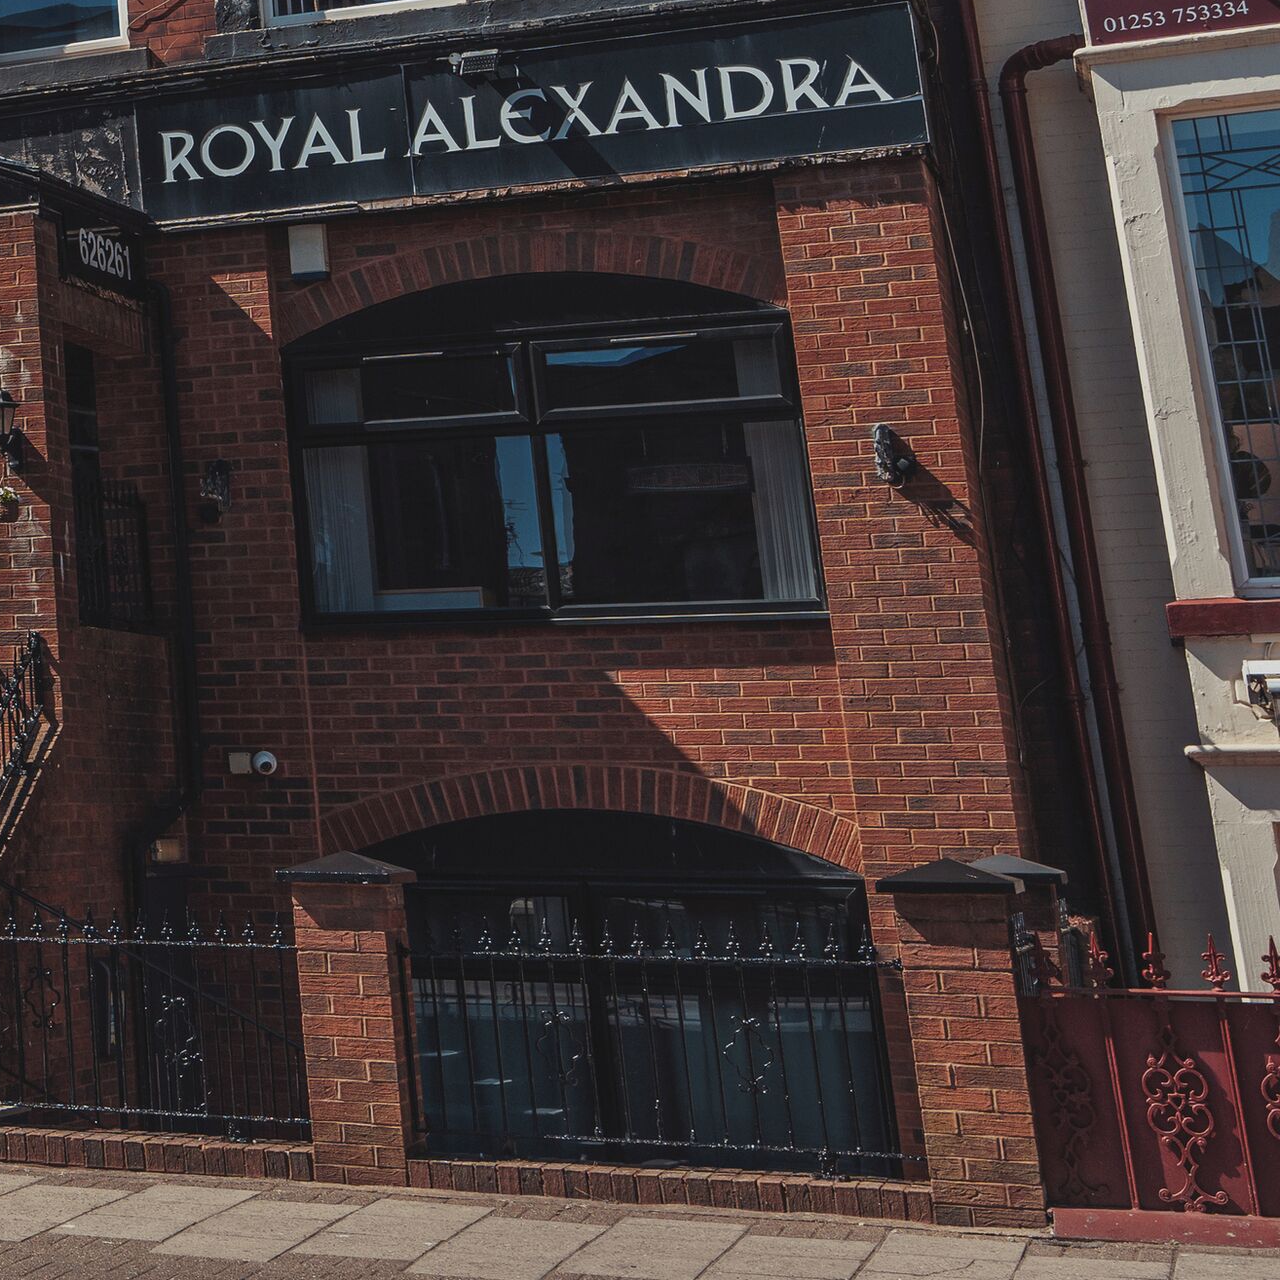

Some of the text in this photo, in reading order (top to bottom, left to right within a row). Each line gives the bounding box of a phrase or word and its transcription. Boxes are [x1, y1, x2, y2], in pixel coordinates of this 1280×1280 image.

[1103, 0, 1250, 33] 01253 753334
[160, 55, 895, 184] ROYAL ALEXANDRA
[79, 227, 132, 281] 626261
